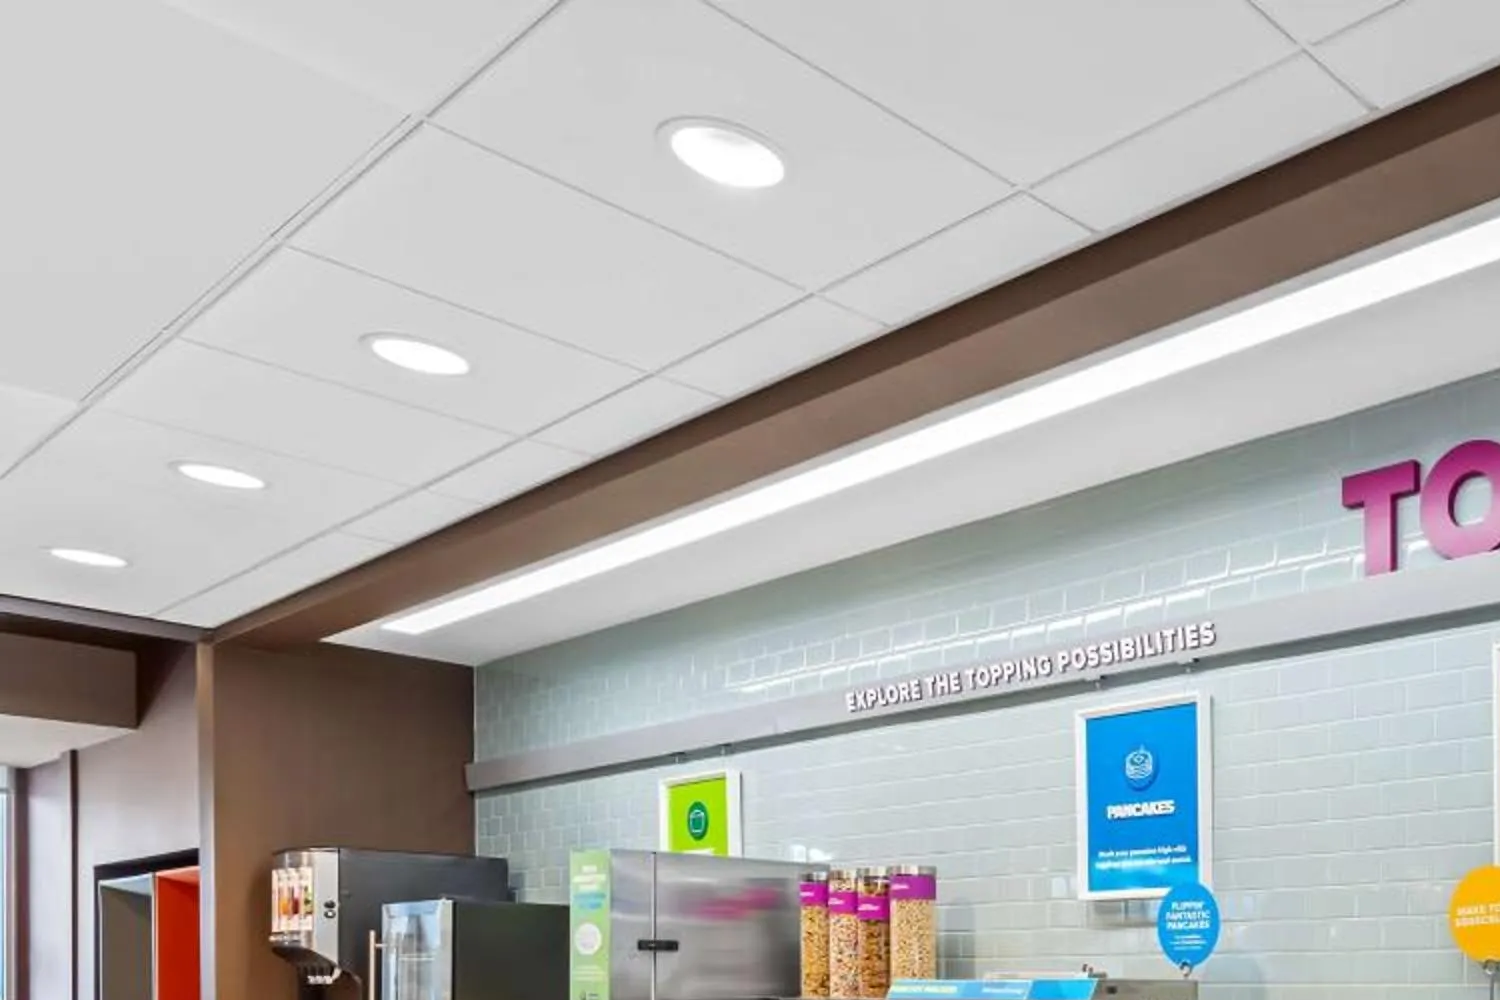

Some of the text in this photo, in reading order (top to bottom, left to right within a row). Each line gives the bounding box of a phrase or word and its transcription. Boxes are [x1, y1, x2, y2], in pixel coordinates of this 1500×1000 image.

[845, 621, 1218, 713] EXPLORE THE TOPPING POSSIBILITIES
[1106, 799, 1176, 820] PANCAKES
